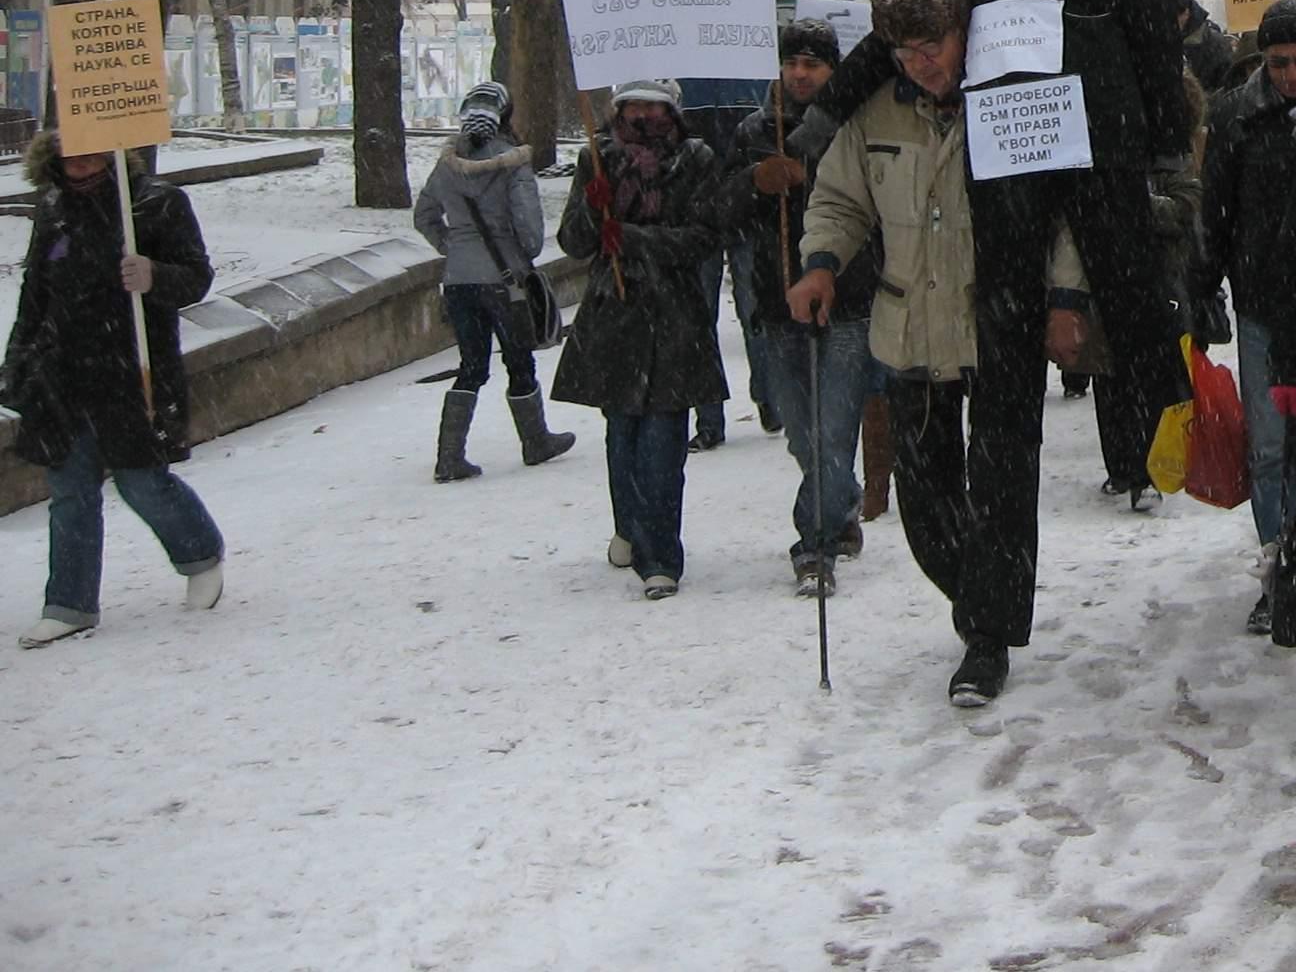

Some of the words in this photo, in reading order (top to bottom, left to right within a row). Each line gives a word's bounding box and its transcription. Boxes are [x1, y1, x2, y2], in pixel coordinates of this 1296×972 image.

[71, 24, 122, 40] КОЯТО
[126, 21, 147, 34] НЕ
[698, 22, 775, 48] НАУКА
[75, 38, 147, 56] РАЗВИВА
[130, 53, 151, 66] СЕ
[71, 104, 81, 115] В
[86, 94, 162, 113] КОЛОНИЯ!
[979, 96, 993, 108] АЗ
[996, 85, 1071, 105] ПРОФЕСОР
[980, 110, 1008, 123] СЪМ
[1012, 103, 1059, 118] ГОЛЯМ
[1062, 100, 1072, 111] И
[992, 123, 1011, 136] СИ
[1014, 117, 1061, 134] ПРАВЯ
[1040, 133, 1060, 145] СИ
[1009, 149, 1052, 165] ЗНАМ!
